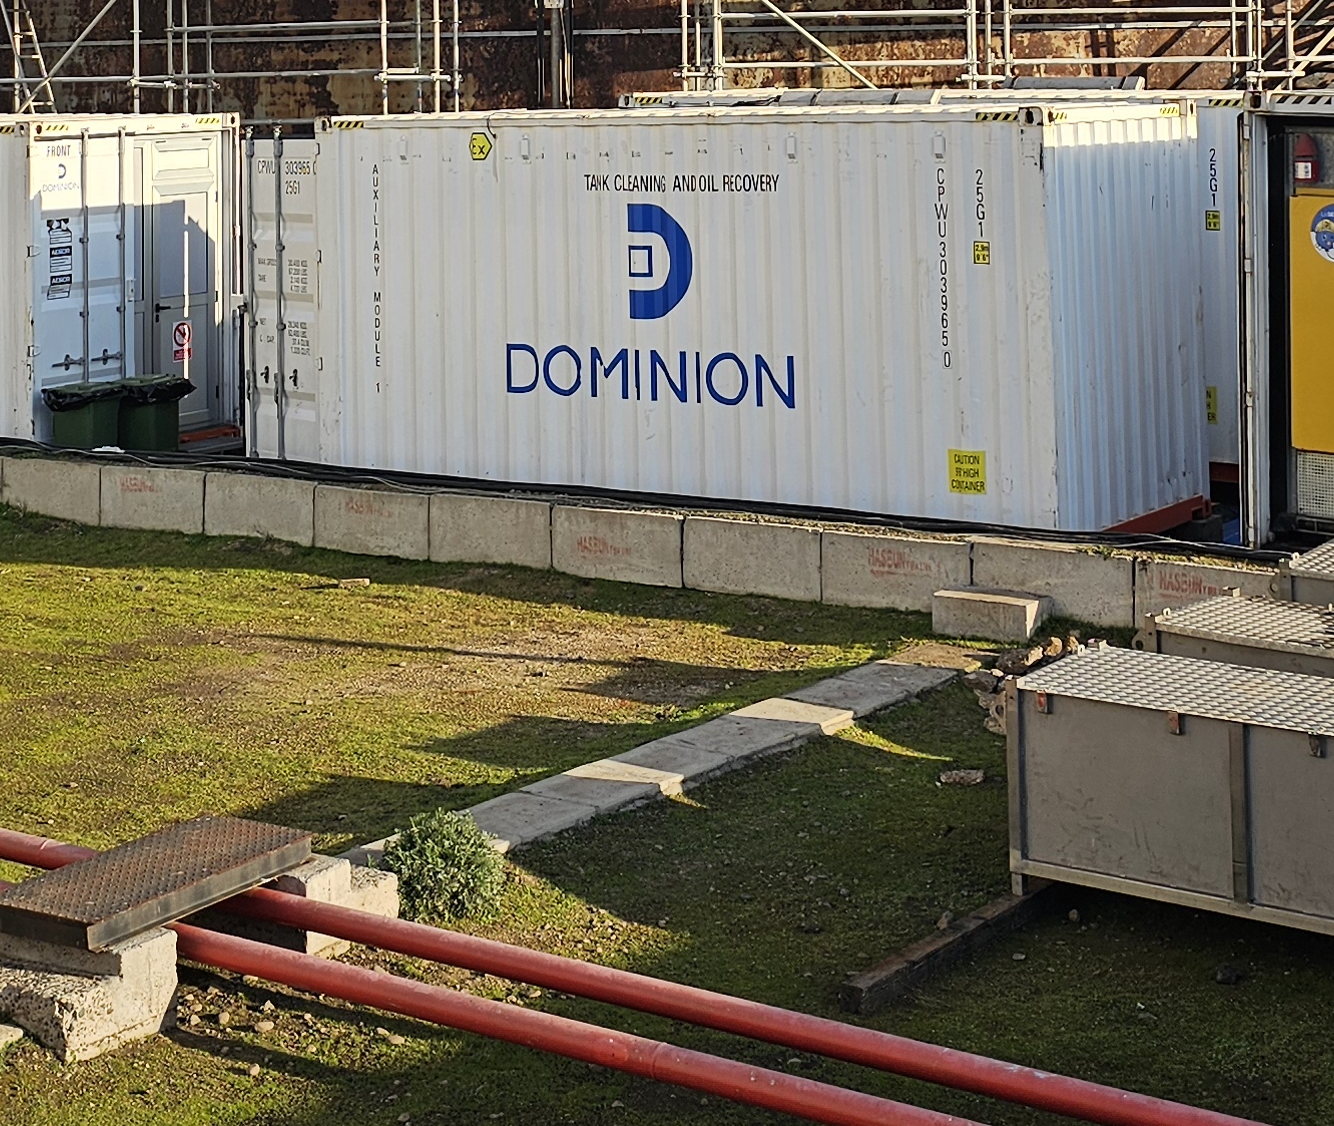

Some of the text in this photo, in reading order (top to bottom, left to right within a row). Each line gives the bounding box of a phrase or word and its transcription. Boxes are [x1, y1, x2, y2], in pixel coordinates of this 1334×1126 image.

[584, 174, 780, 193] TANK CLEANING AND OIL RECOVERY
[935, 168, 949, 238] CPWU
[975, 169, 986, 238] 25G1
[1209, 148, 1218, 207] 25G1
[372, 163, 381, 277] AUXILIARY
[373, 291, 381, 368] MODULE
[506, 343, 796, 409] DOMINION
